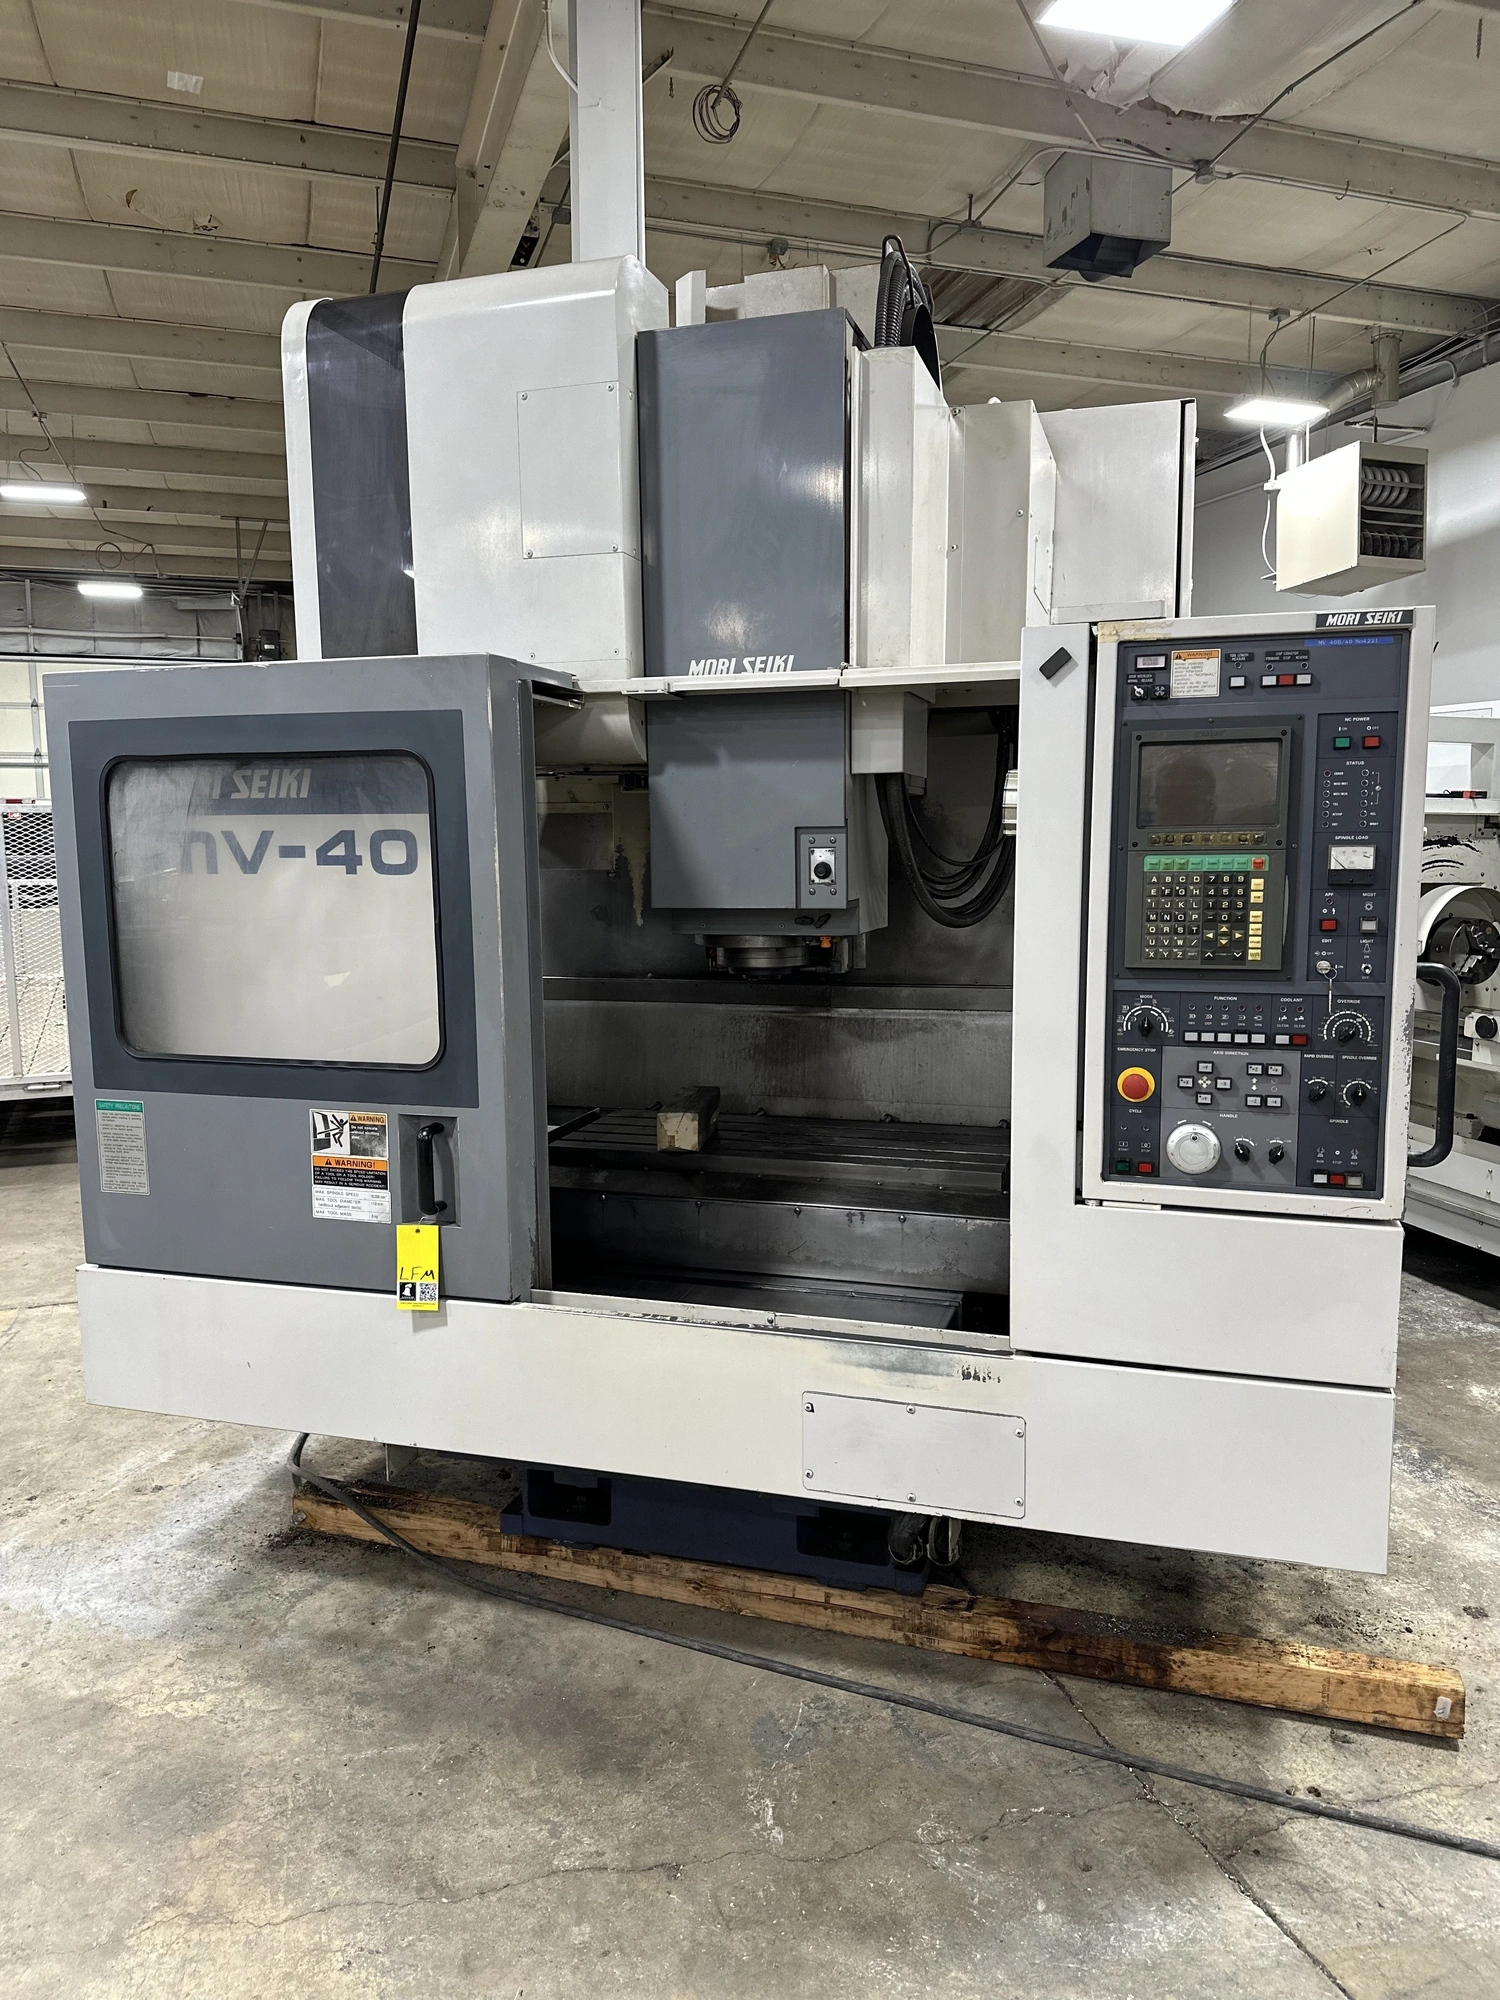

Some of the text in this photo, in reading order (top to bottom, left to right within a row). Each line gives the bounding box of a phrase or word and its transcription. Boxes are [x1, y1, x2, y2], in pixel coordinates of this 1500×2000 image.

[1326, 611, 1403, 626] MORI SEIKI
[689, 655, 795, 677] MORI SEIKI
[231, 768, 312, 799] SEIKI
[335, 1159, 375, 1168] WARNING!
[400, 1266, 435, 1280] LFM
